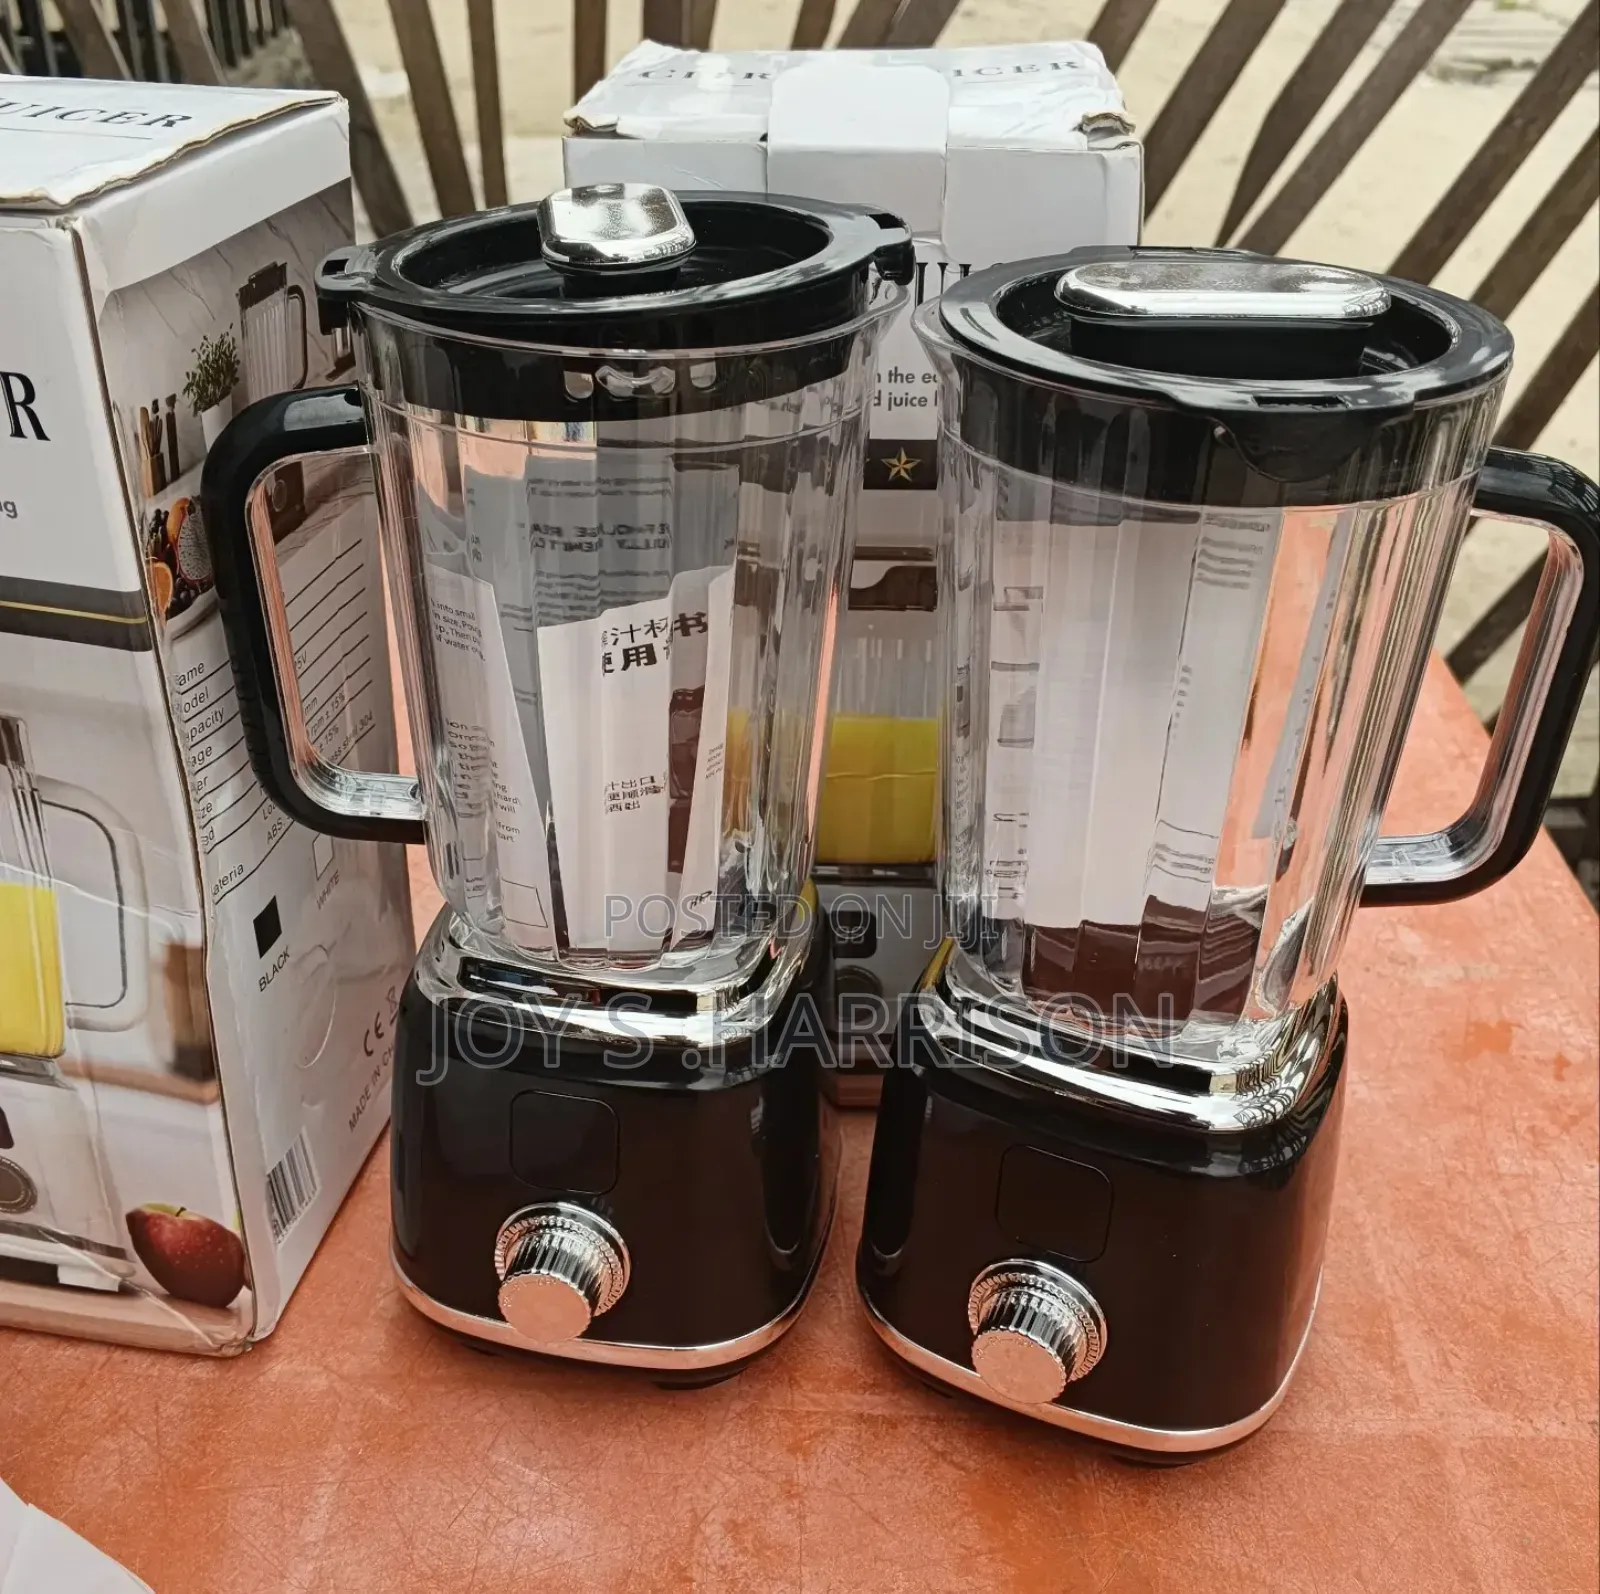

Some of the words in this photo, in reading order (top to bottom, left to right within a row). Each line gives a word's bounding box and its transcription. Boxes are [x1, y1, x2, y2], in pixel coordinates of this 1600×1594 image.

[0, 98, 192, 128] UICER
[887, 366, 916, 384] the
[887, 392, 929, 412] juice
[176, 662, 205, 687] ame
[174, 685, 209, 714] odel
[186, 706, 225, 742] pacity
[316, 868, 340, 911] WHITE
[258, 944, 291, 993] BLACK
[348, 1083, 372, 1133] MADE
[371, 1064, 381, 1087] IN
